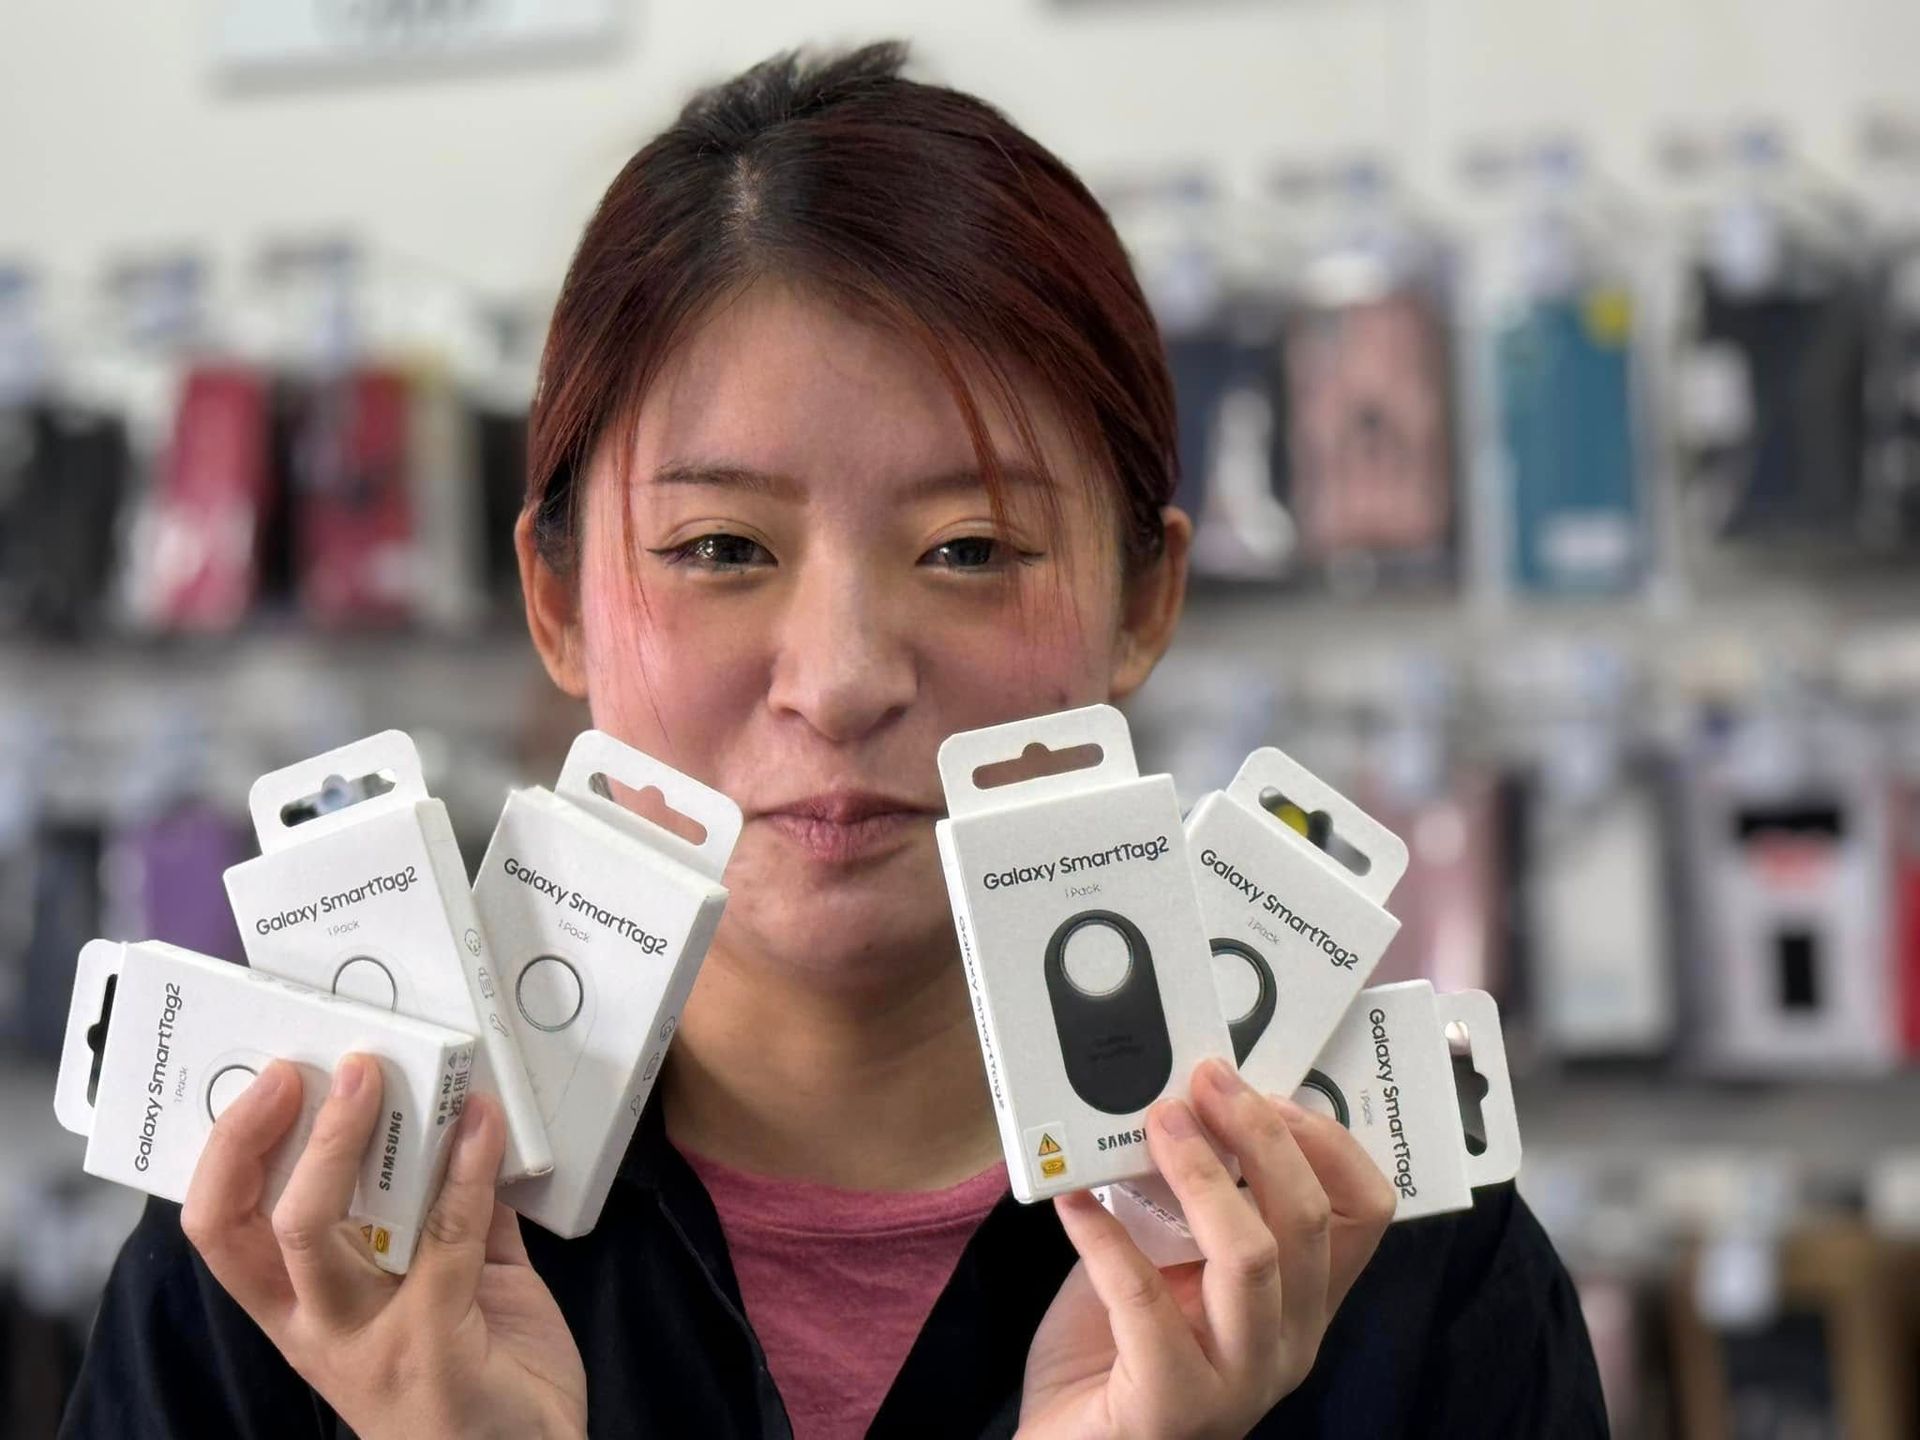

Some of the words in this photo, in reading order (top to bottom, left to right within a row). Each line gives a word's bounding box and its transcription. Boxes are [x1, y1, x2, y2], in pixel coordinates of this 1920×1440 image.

[256, 902, 318, 936] Galaxy
[320, 865, 418, 913] SmartTag2
[503, 857, 569, 905] Galaxy
[568, 892, 668, 956] SmartTag2
[983, 861, 1056, 890] Galaxy
[1059, 835, 1170, 874] SmartTag2
[1200, 849, 1265, 903] Galaxy
[1262, 894, 1359, 970] SmartTag2
[148, 982, 183, 1096] SmartTag2
[134, 1096, 163, 1172] Galaxy
[1369, 1008, 1394, 1082] Galaxy
[1383, 1085, 1417, 1199] SmartTag2
[379, 1110, 403, 1191] SAMSUNG
